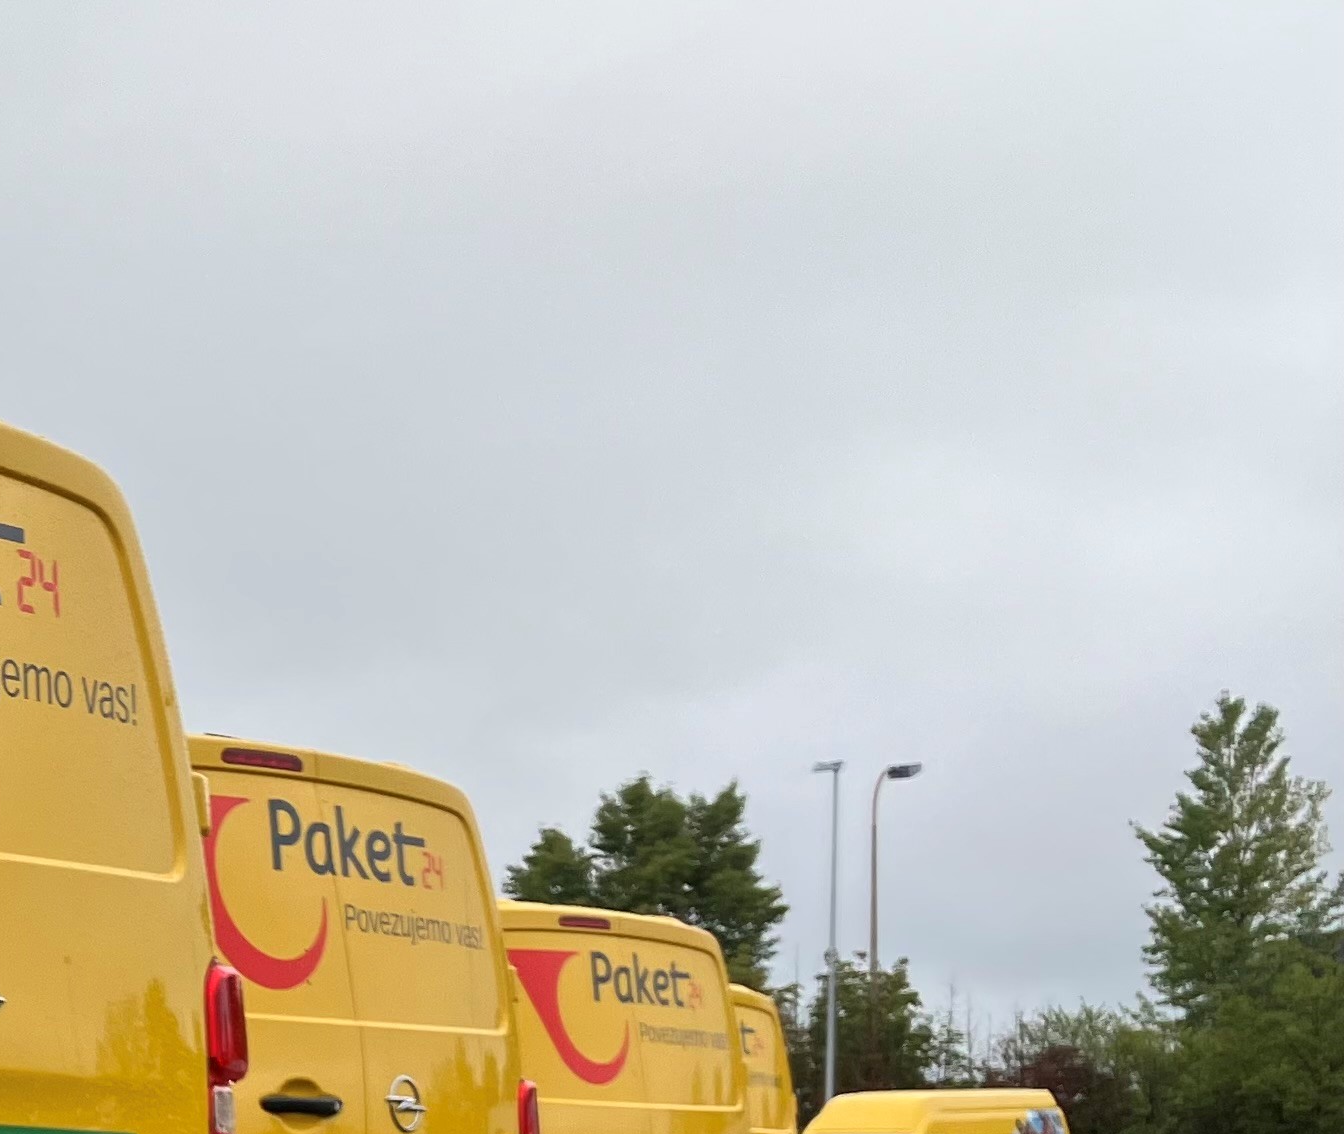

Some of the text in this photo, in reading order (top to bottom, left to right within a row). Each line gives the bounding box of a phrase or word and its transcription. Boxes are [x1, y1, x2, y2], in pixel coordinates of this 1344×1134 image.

[16, 549, 61, 618] 24
[81, 676, 138, 726] vas!
[268, 798, 444, 890] Paket 24
[344, 903, 452, 946] Povezujemo
[590, 950, 691, 1008] Paket
